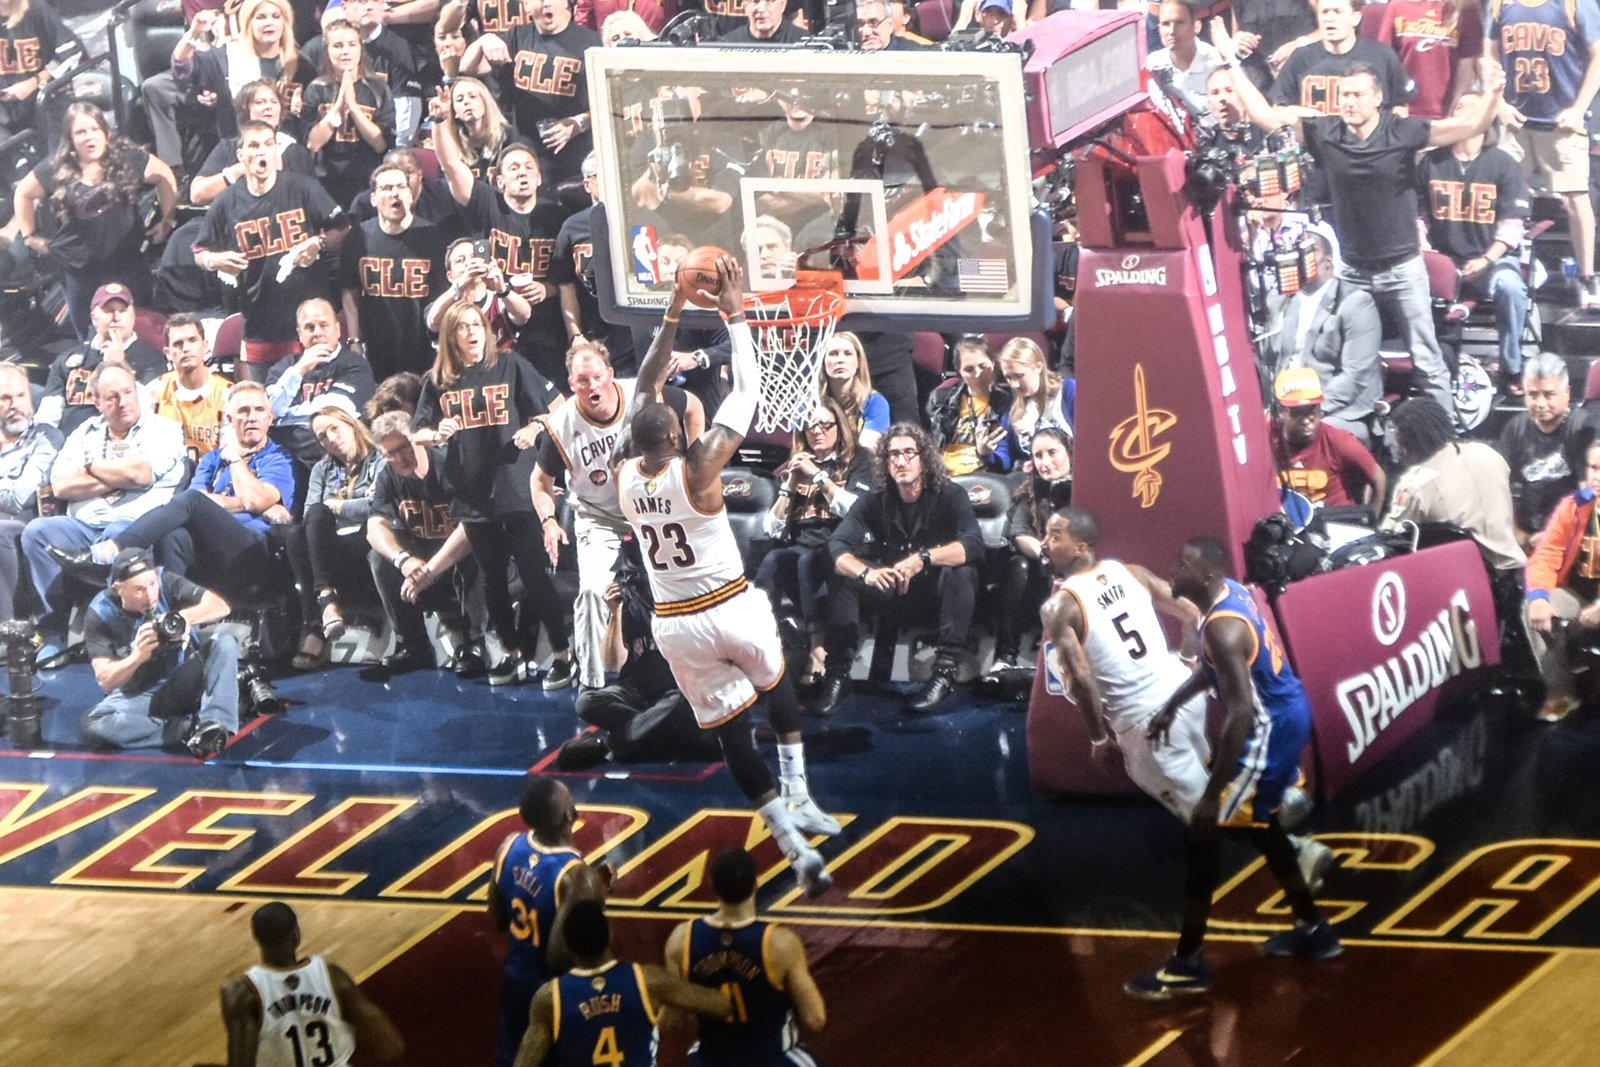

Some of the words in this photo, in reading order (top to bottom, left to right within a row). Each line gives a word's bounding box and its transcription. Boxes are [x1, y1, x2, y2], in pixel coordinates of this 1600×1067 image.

[1502, 22, 1566, 57] CAVS
[514, 50, 581, 96] CLE
[1515, 57, 1551, 94] 23
[1302, 75, 1341, 116] CL
[1430, 180, 1497, 223] CLE
[234, 208, 308, 260] CLE
[489, 228, 556, 278] CLE
[360, 256, 431, 298] CLE
[1095, 267, 1167, 288] SPALDING
[627, 296, 668, 307] SPALDING
[440, 384, 509, 430] CLE
[581, 433, 617, 467] CAVA
[633, 497, 672, 515] JAMES
[640, 522, 697, 571] 23
[1097, 584, 1126, 610] SMITH
[1111, 611, 1147, 660] 5
[1336, 589, 1483, 764] SPALDING
[510, 897, 540, 949] 31
[284, 1020, 335, 1067] 13
[592, 1026, 625, 1067] 4
